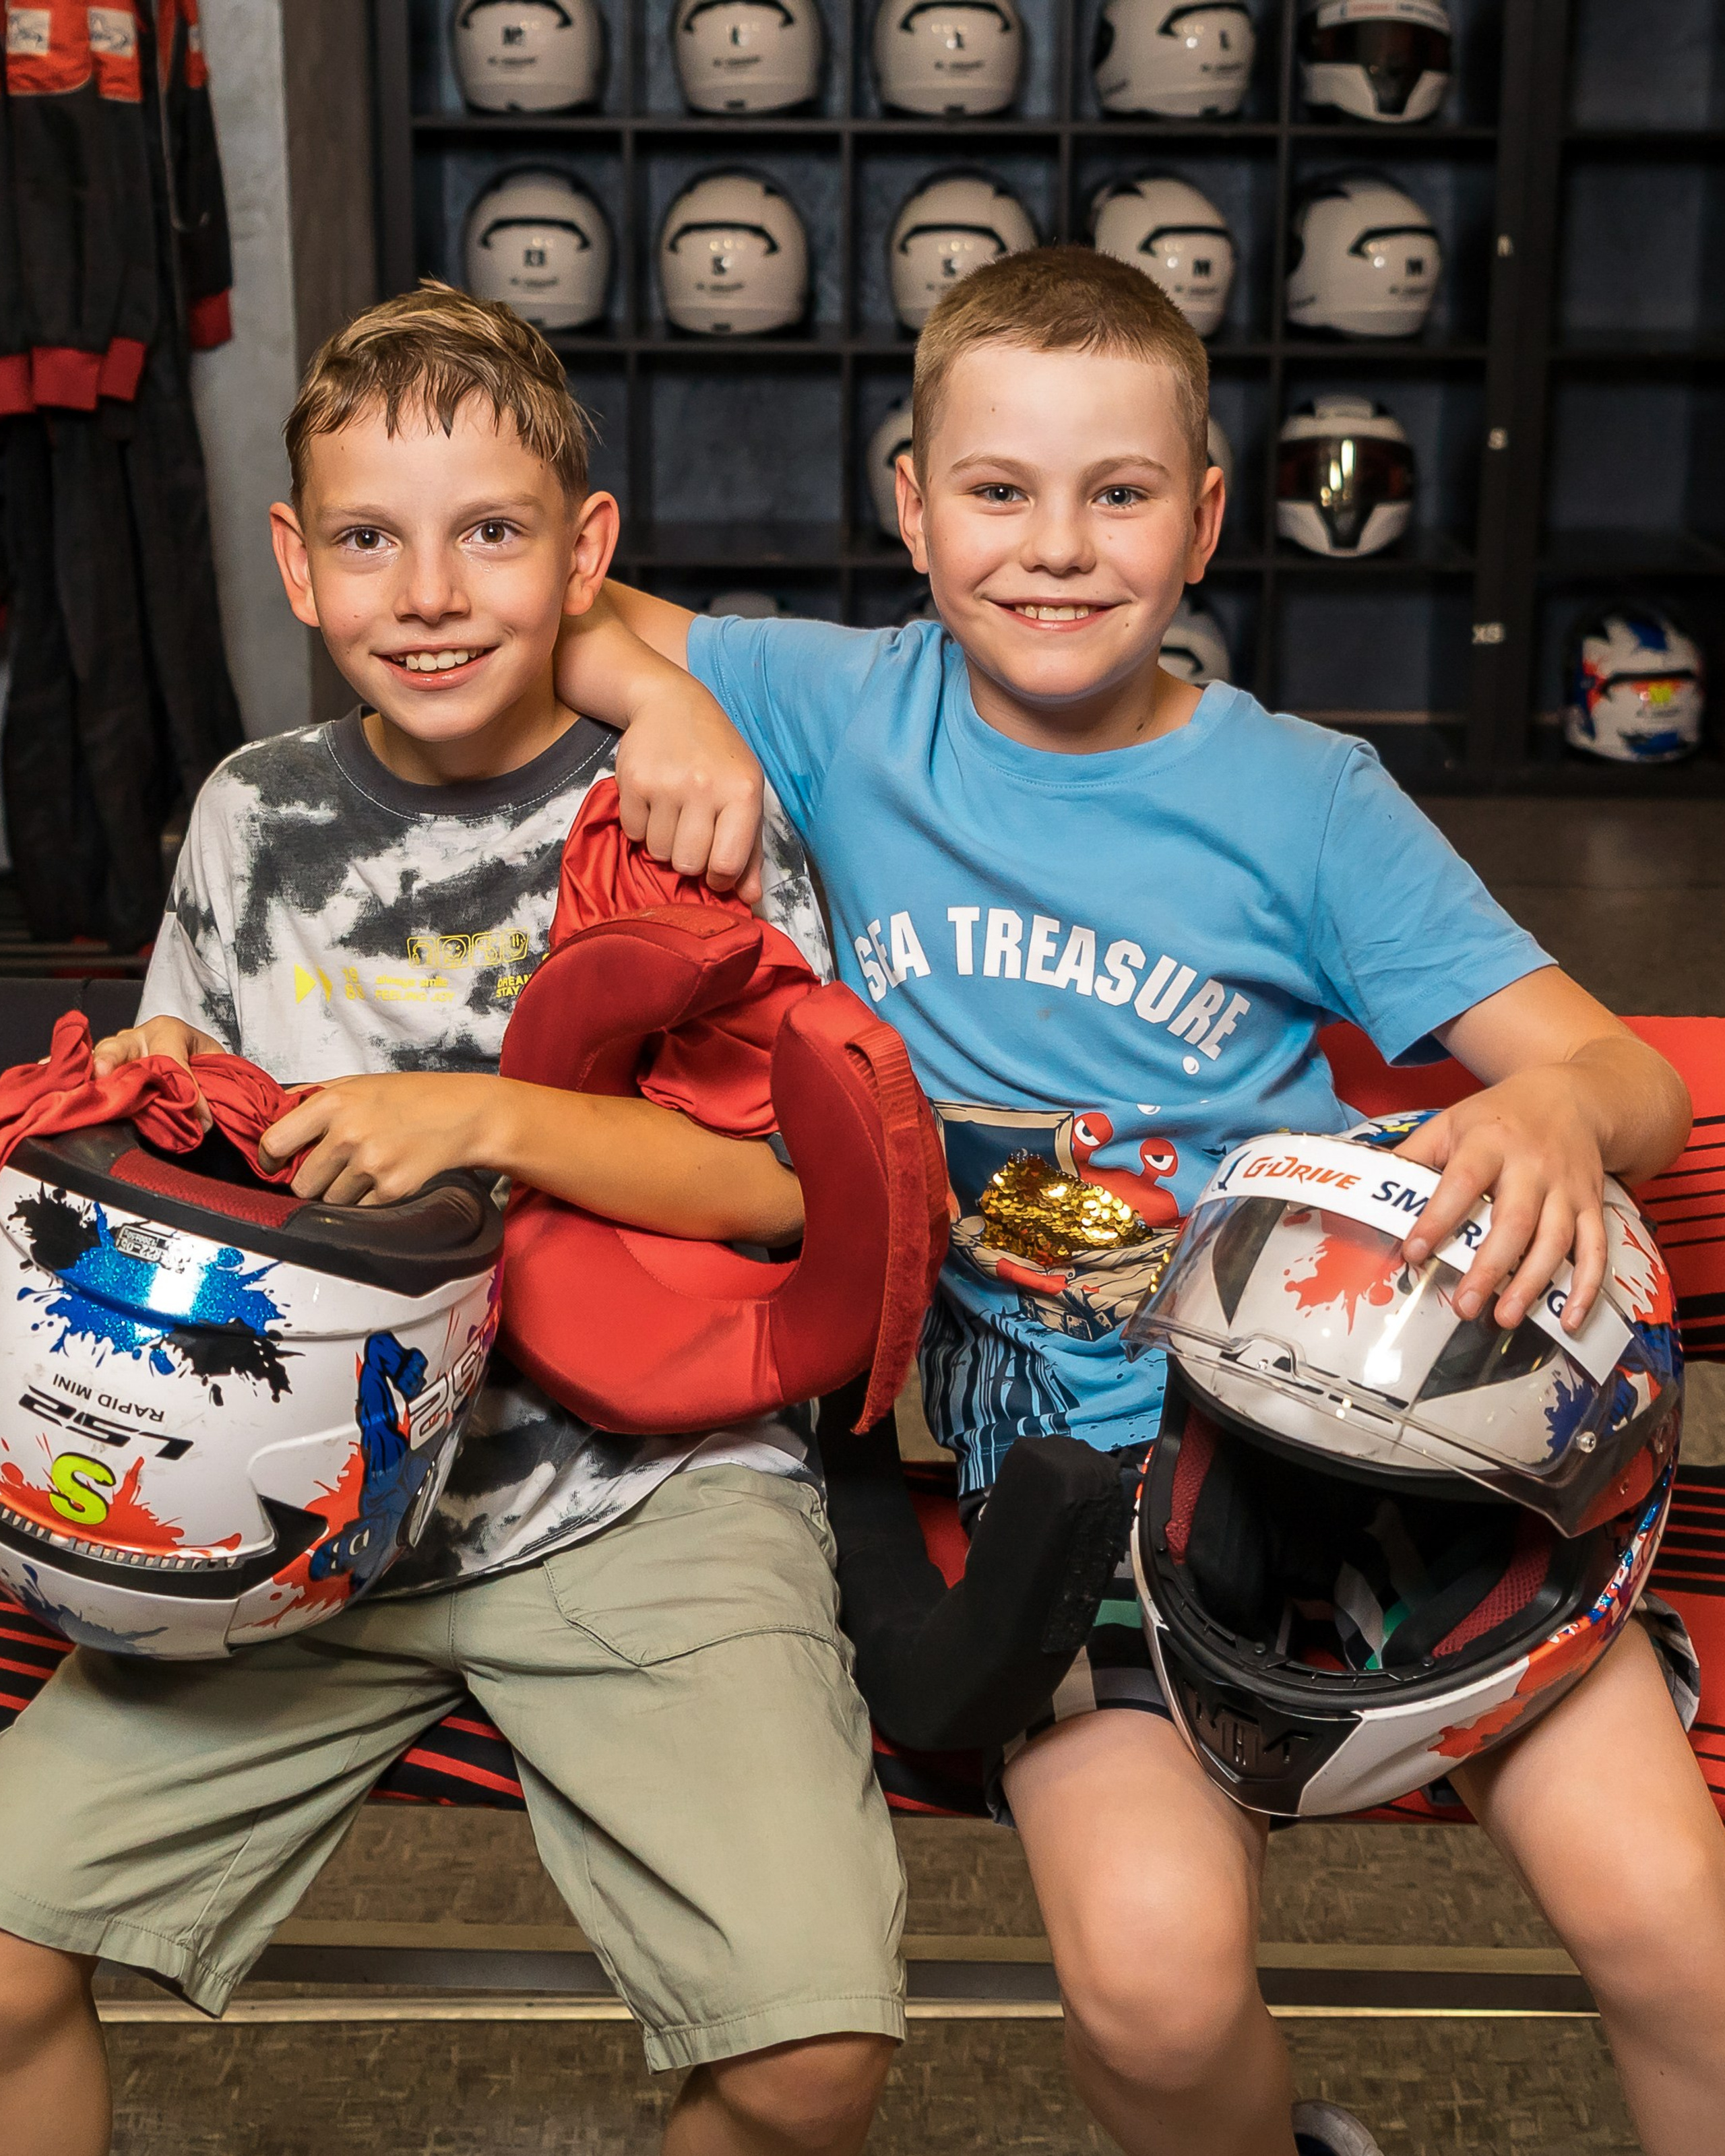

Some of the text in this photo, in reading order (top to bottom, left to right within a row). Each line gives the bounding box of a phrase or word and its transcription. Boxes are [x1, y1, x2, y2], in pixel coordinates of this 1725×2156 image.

[854, 906, 1251, 1060] SEA TREASURE
[18, 1385, 195, 1461] LS2
[52, 1373, 165, 1423] RAPID MINI
[49, 1452, 117, 1525] S
